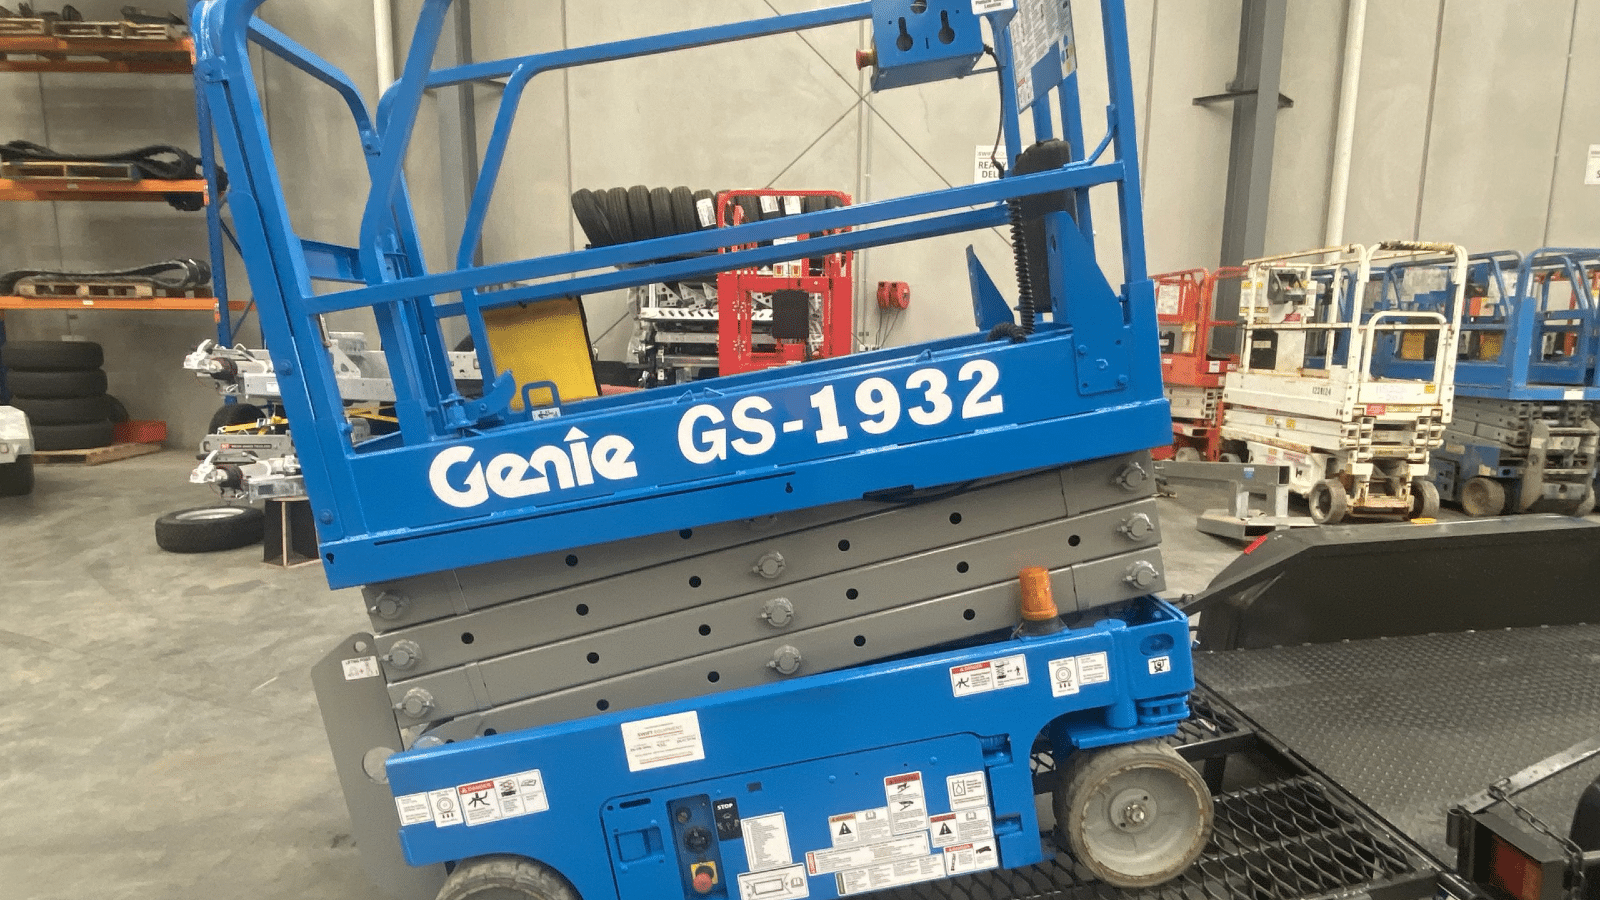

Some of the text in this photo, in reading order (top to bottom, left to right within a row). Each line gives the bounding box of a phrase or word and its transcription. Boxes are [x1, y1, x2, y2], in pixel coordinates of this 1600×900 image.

[978, 161, 1007, 170] REAY
[981, 170, 999, 179] DEL
[429, 359, 1004, 508] Genie GS-1932
[716, 802, 734, 811] STOP
